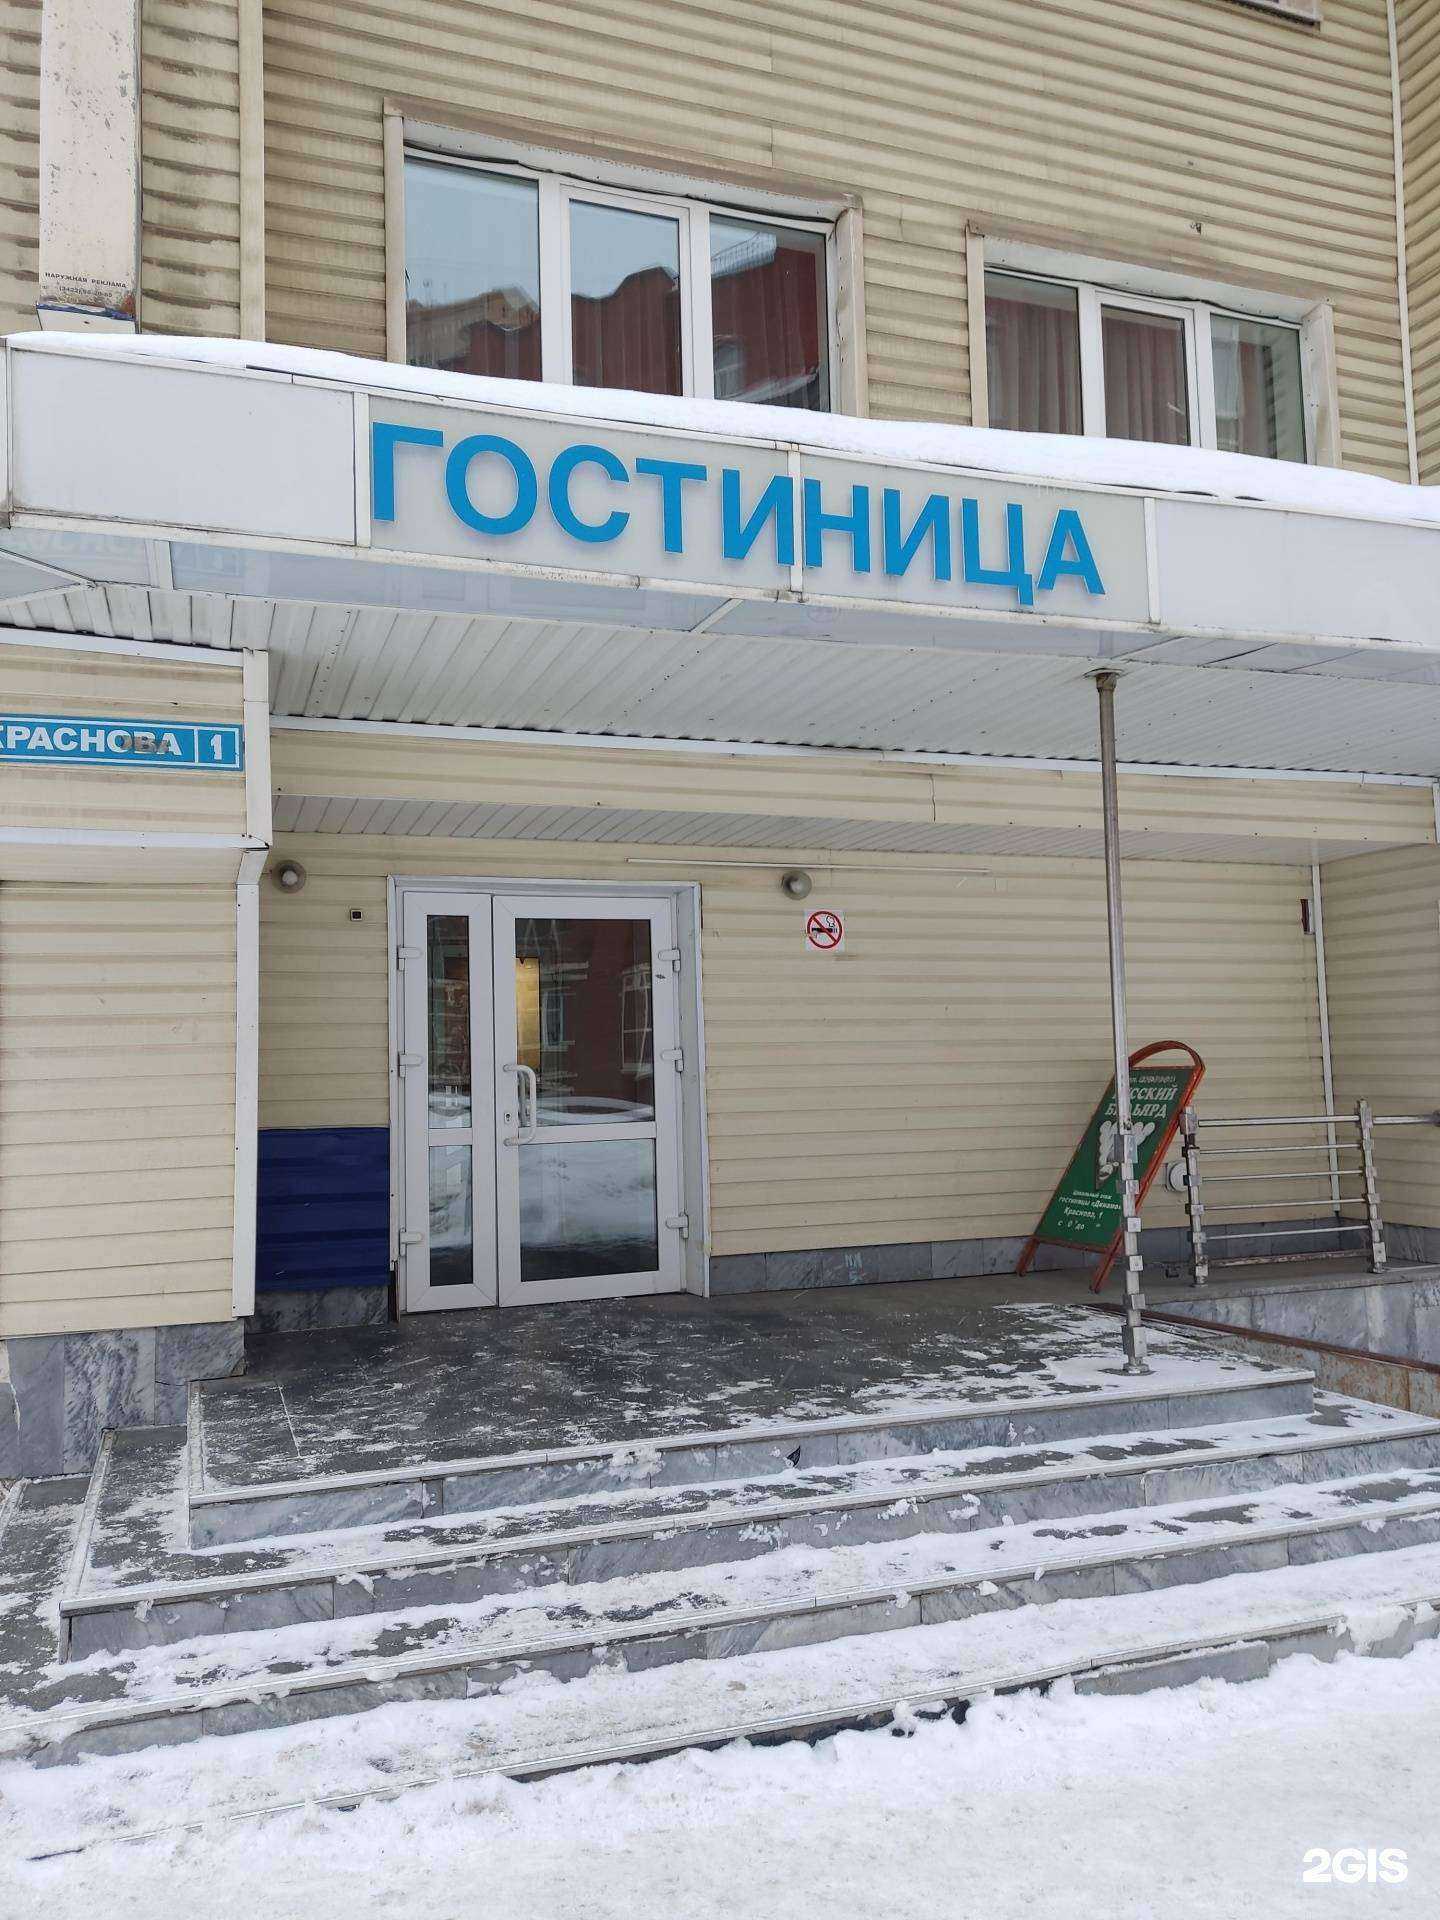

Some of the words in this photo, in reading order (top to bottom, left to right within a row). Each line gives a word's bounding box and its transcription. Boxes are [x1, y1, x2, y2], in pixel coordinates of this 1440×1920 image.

[45, 272, 88, 283] НАРУЖНАЯ
[91, 279, 127, 289] РЕКЛАМА
[373, 422, 1105, 606] ГОСТИНИЦА
[210, 734, 223, 760] 1
[1111, 1084, 1178, 1101] ССКИЙ
